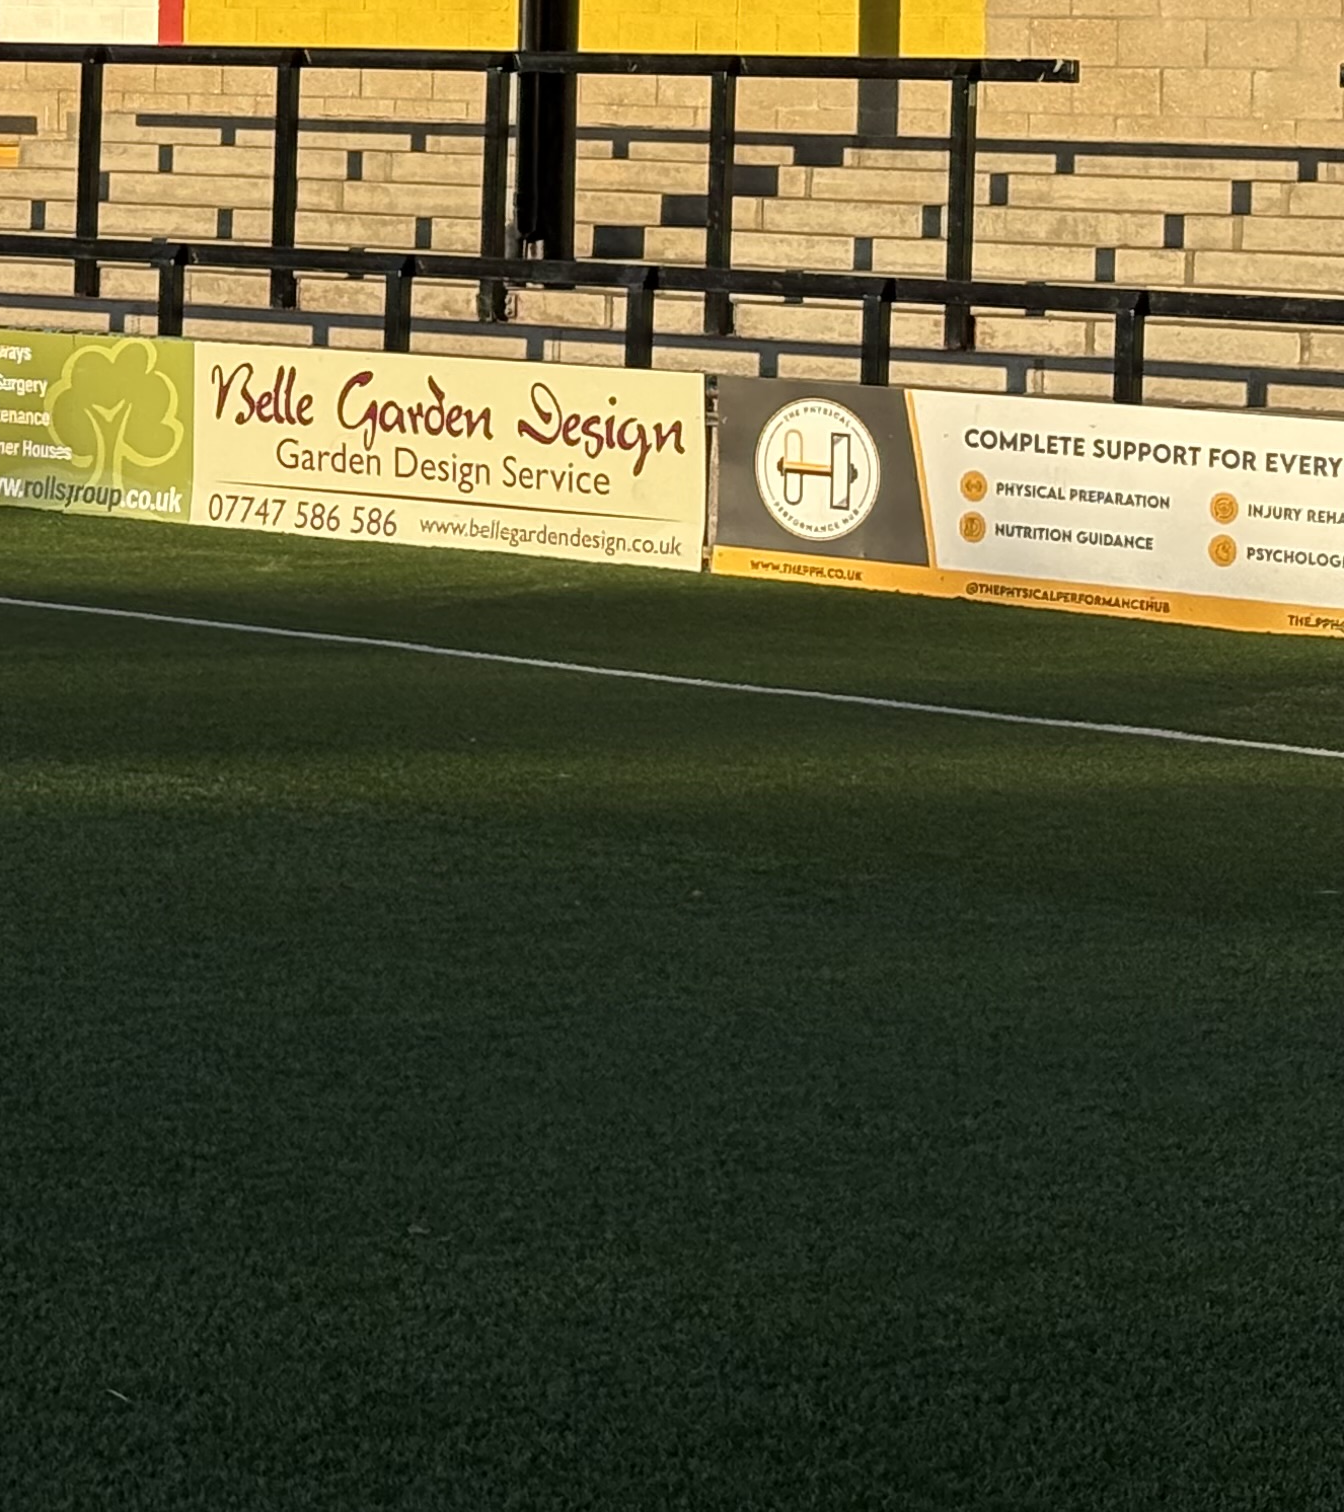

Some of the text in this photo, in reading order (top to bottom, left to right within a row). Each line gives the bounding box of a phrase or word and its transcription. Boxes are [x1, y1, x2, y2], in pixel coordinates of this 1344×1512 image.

[211, 363, 687, 478] Belle Garden Design
[21, 439, 73, 462] Houses
[275, 437, 611, 495] Garden Design Service
[964, 428, 1343, 478] COMPLETE SUPPORT FOR EVERY
[995, 481, 1170, 509] PHYSICAL PREPARATION
[1248, 503, 1303, 522] INJURY
[208, 492, 683, 557] 07747 586 586 www.bellegardendesign.co.uk
[994, 523, 1154, 551] NUTRITION GUIDANCE
